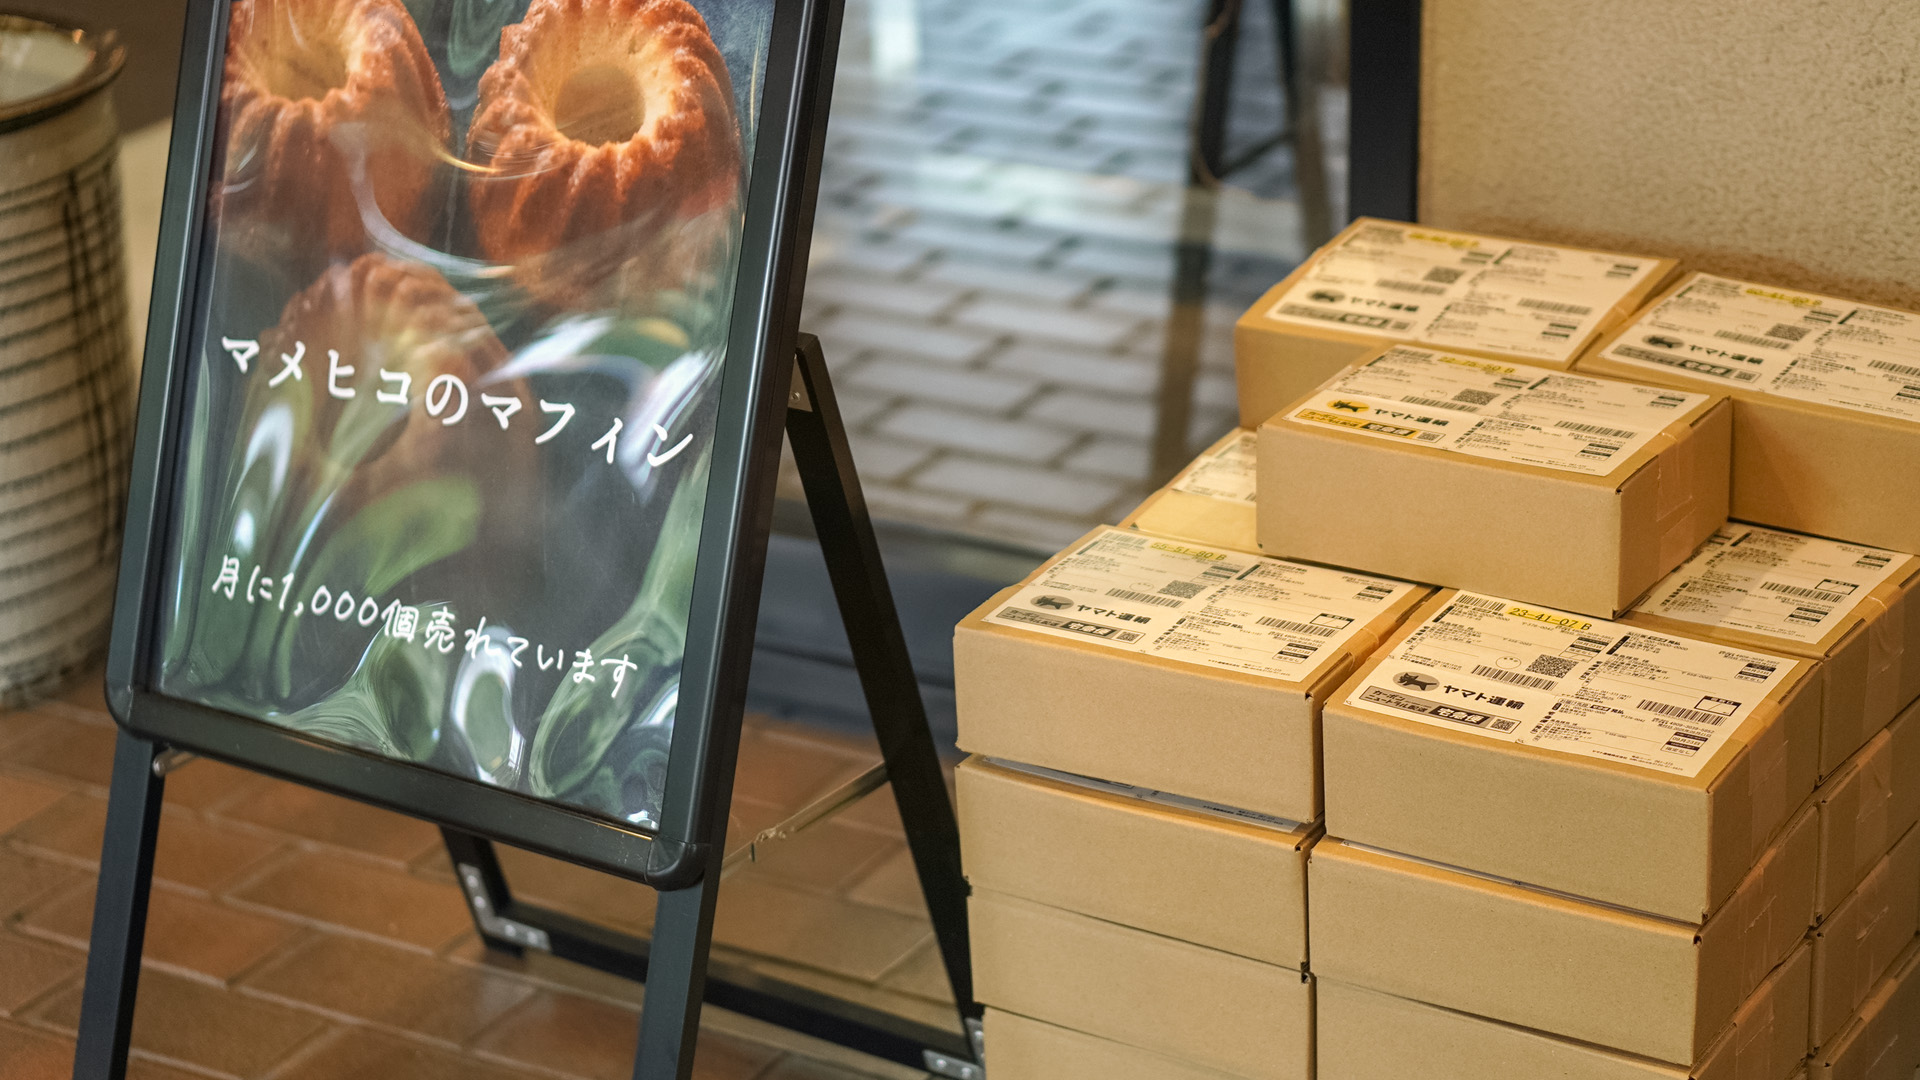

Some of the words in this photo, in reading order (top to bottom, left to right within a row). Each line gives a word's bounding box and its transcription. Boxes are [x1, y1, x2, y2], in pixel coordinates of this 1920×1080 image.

[222, 336, 693, 467] マメヒコのマフィン
[212, 555, 637, 698] 月に1,000個売れています
[1508, 607, 1578, 629] 23-41-07
[1443, 685, 1526, 710] ヤマト運輸
[1437, 707, 1486, 724] 宅急便
